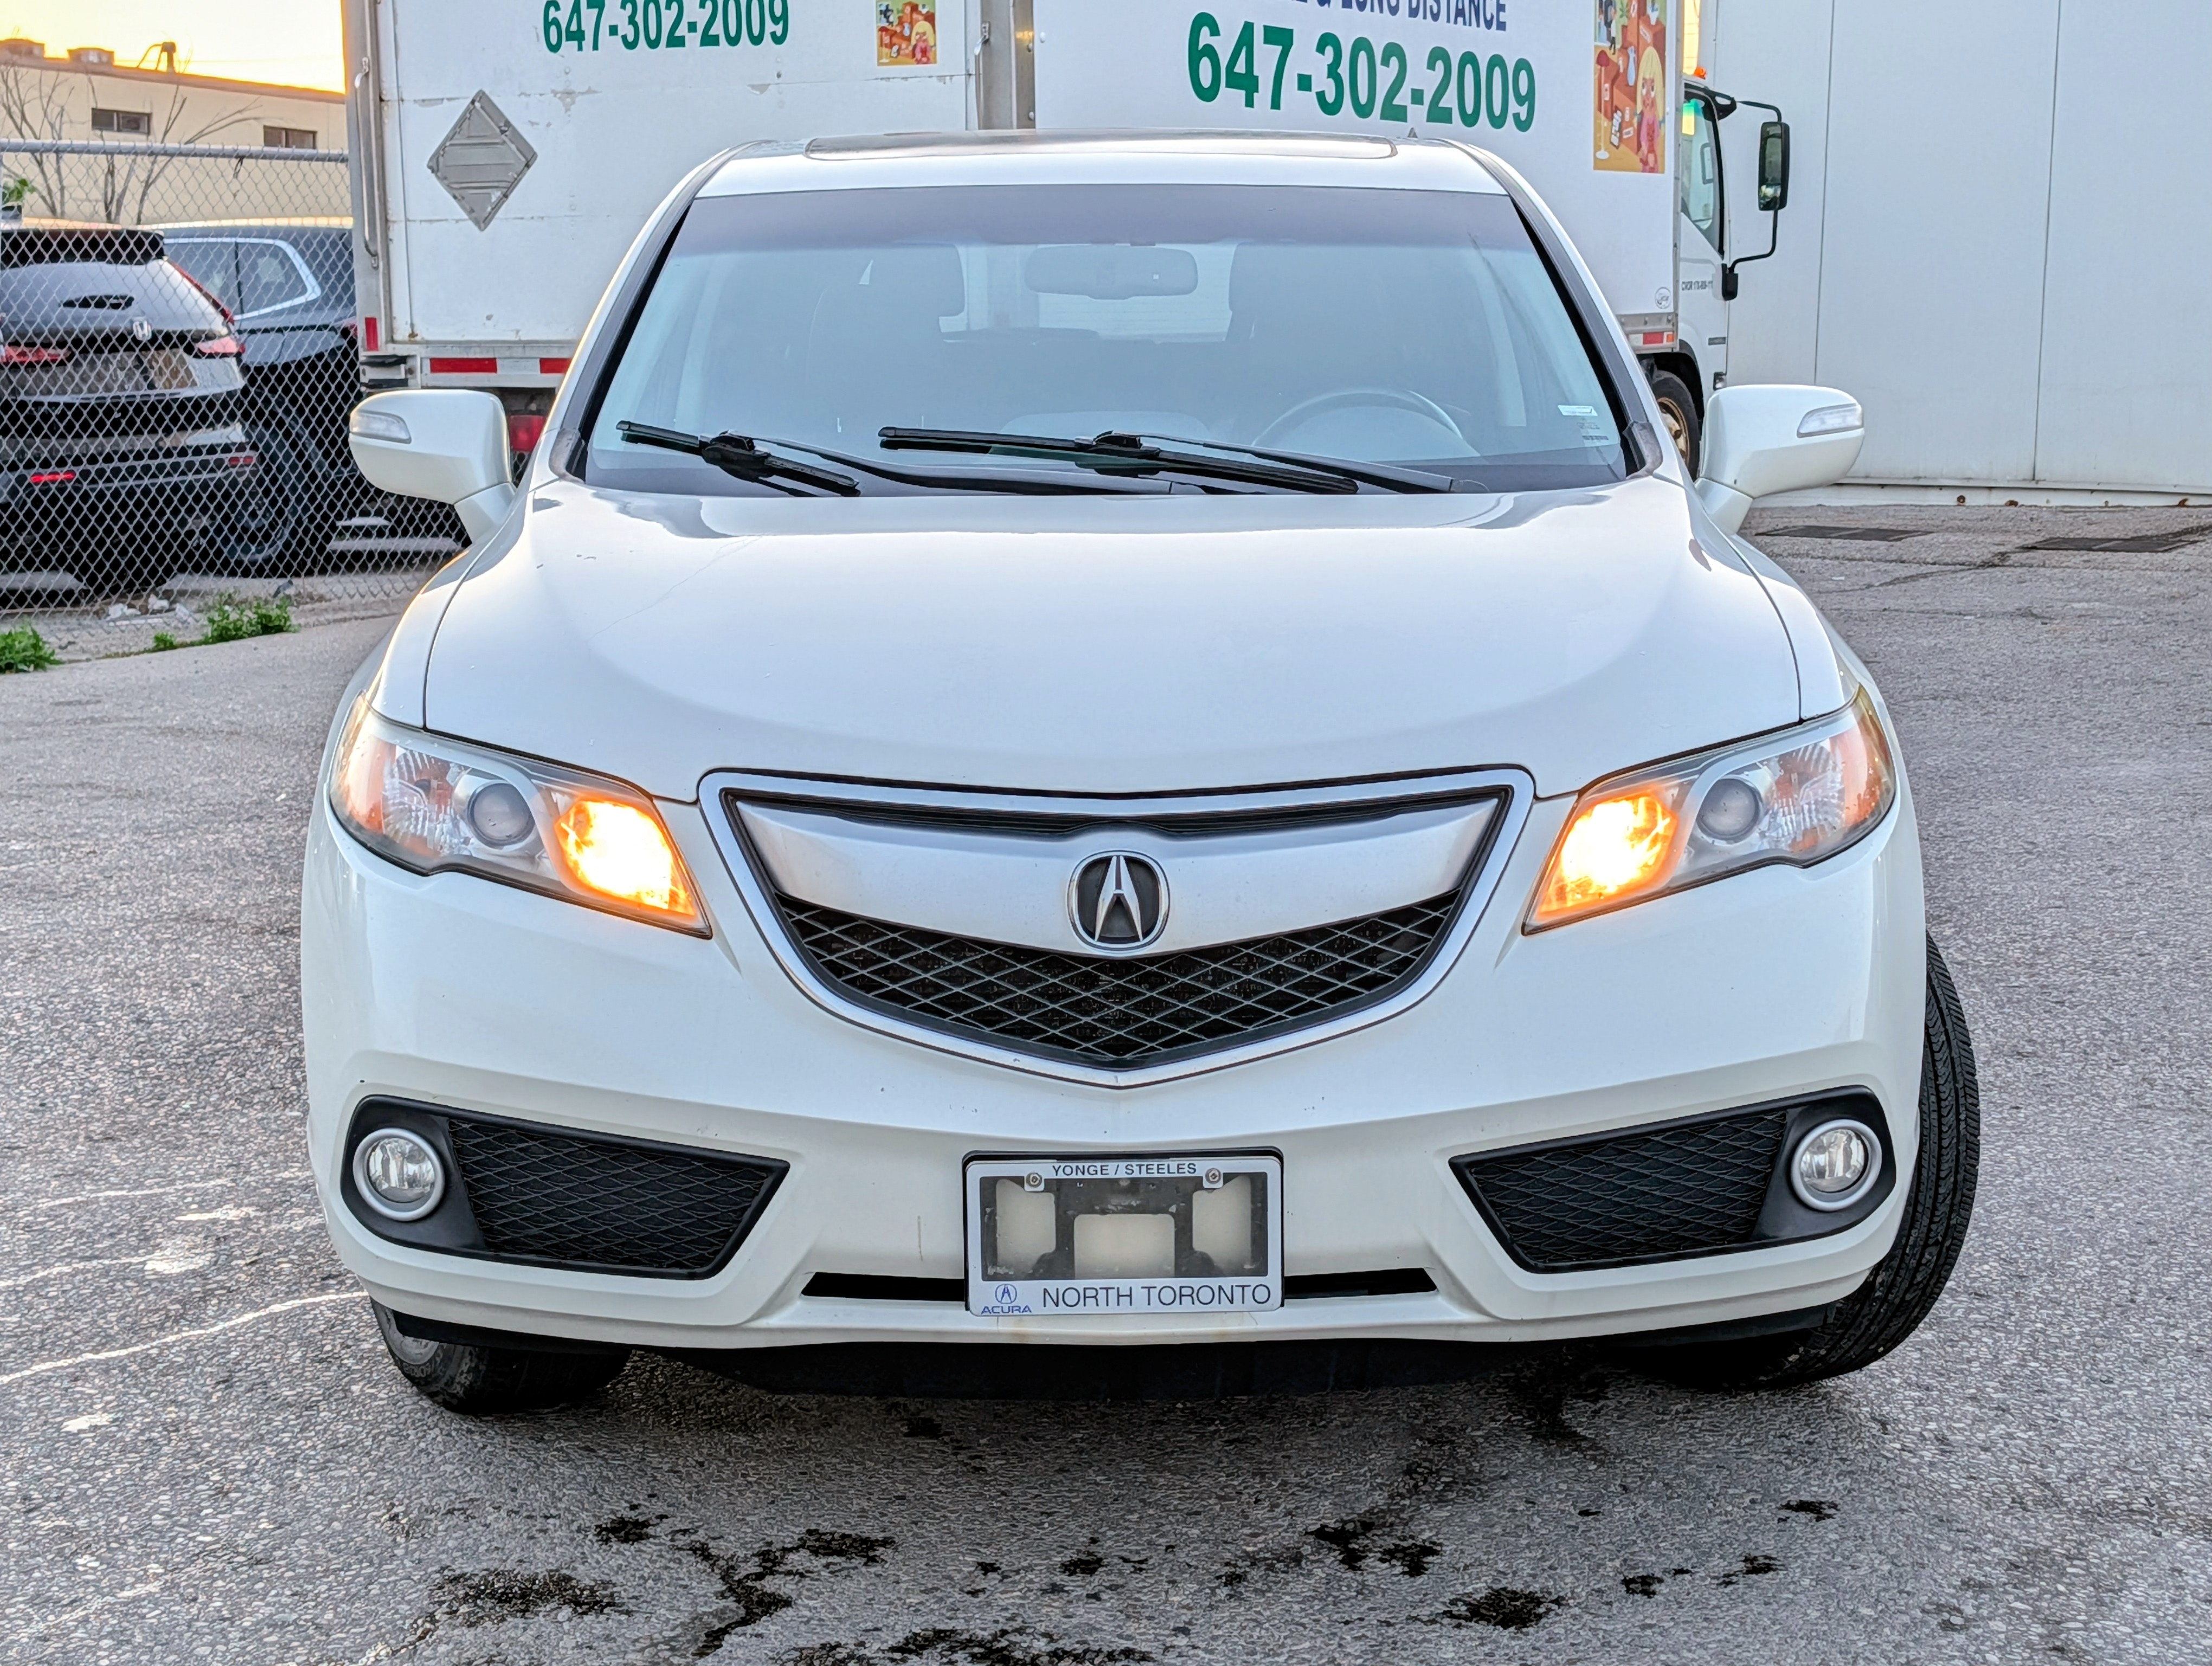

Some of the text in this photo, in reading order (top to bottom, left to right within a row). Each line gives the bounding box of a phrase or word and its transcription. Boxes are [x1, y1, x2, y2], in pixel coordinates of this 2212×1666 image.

[543, 0, 789, 53] 647-302-2009
[1188, 12, 1536, 132] 647-302-2009
[1052, 1164, 1110, 1176] YONGE
[1125, 1163, 1197, 1175] STEELES
[1043, 1284, 1271, 1308] NORTH TORONTO
[981, 1305, 1032, 1315] ACURA
